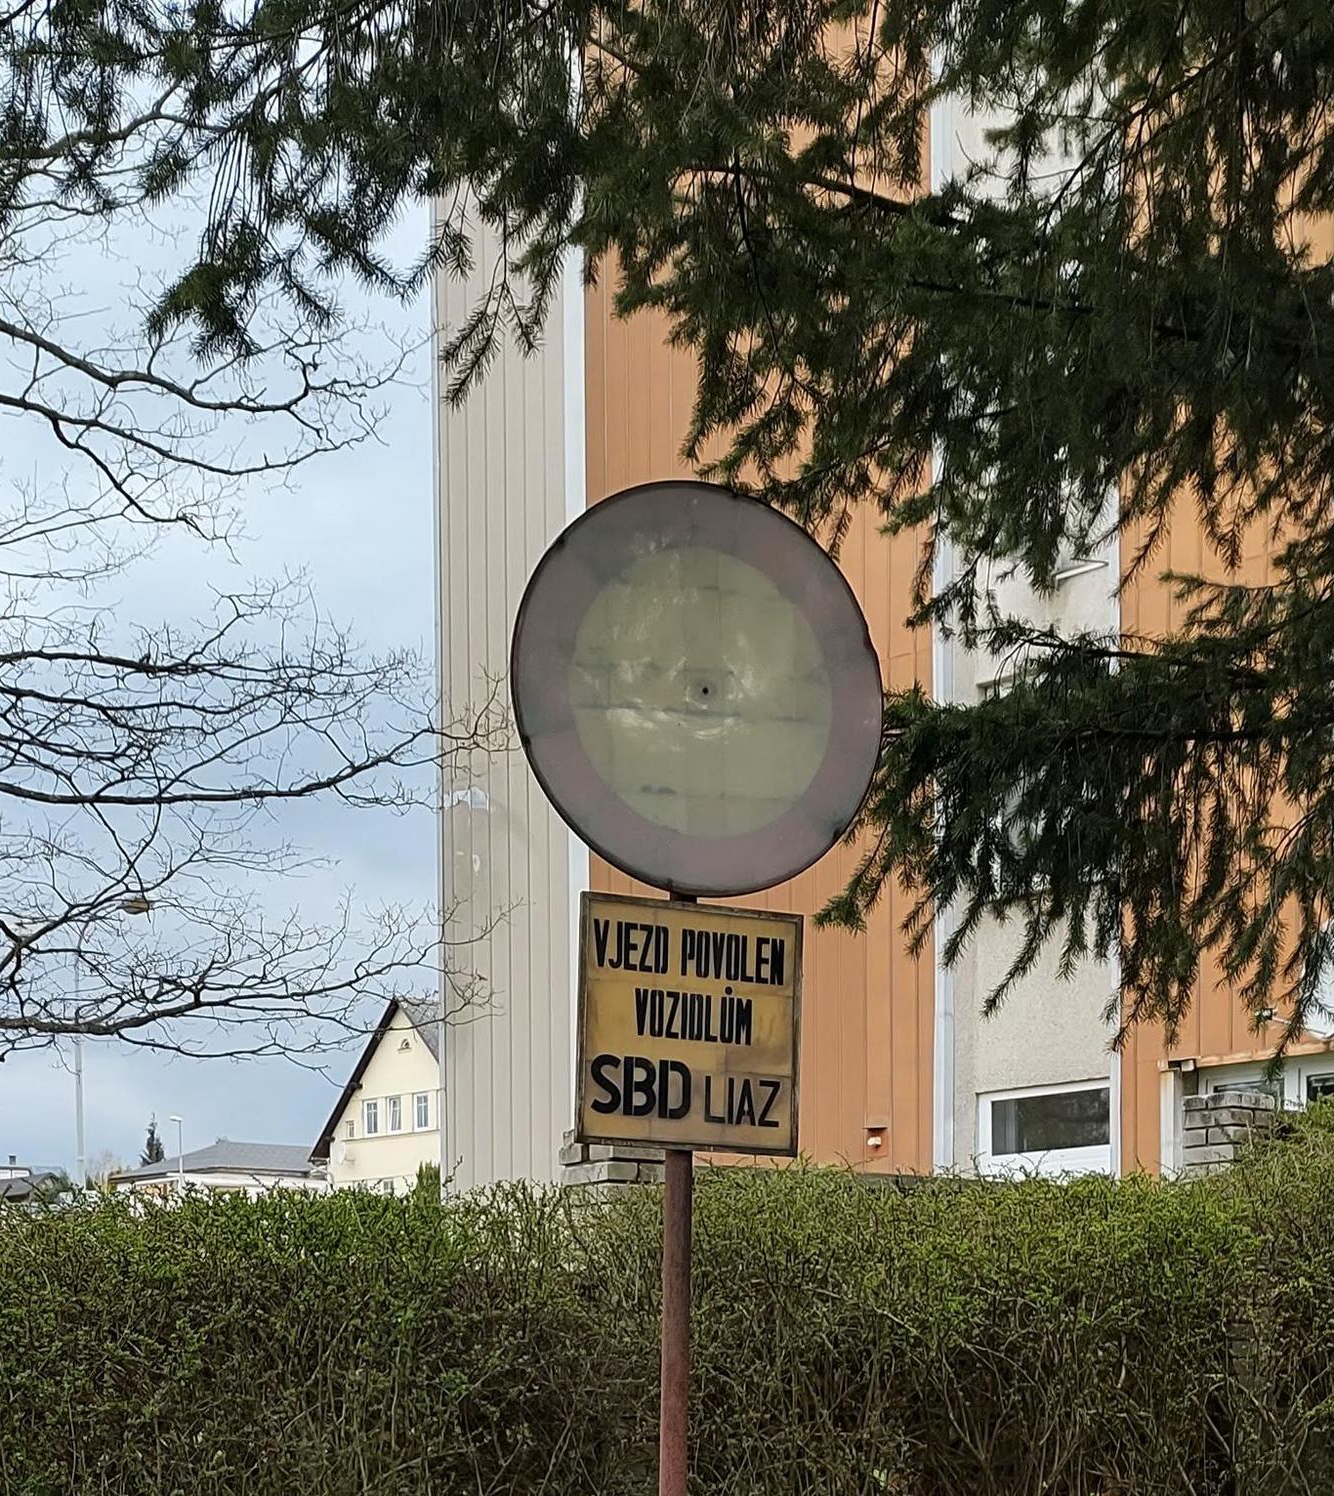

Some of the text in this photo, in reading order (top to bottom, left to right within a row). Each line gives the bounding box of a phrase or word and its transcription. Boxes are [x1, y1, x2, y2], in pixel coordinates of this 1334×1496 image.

[594, 919, 784, 986] VJEZD POVOLEN
[635, 986, 752, 1046] VOZIDLŮM
[590, 1054, 780, 1127] SBD LIAZ
